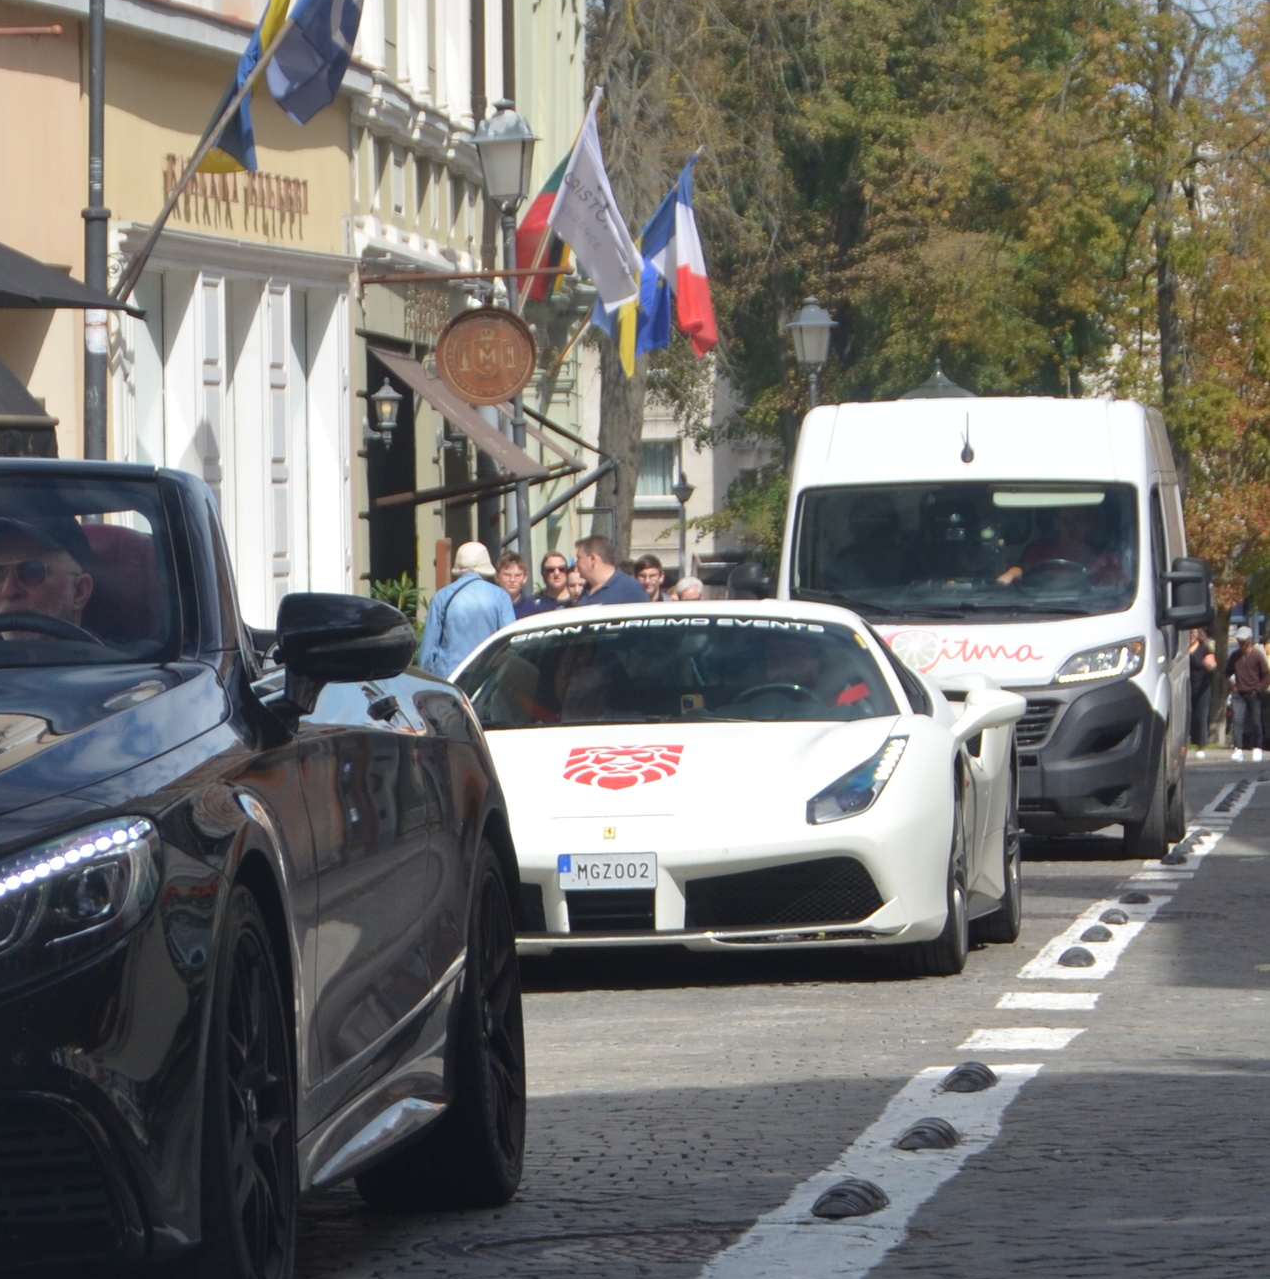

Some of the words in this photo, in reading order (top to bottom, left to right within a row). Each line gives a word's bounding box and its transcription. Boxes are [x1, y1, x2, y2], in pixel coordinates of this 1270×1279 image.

[478, 348, 497, 365] M
[510, 624, 583, 644] GRAN
[588, 617, 710, 632] TURISMO
[716, 617, 826, 634] EVENTS
[577, 862, 650, 880] MGZ002
